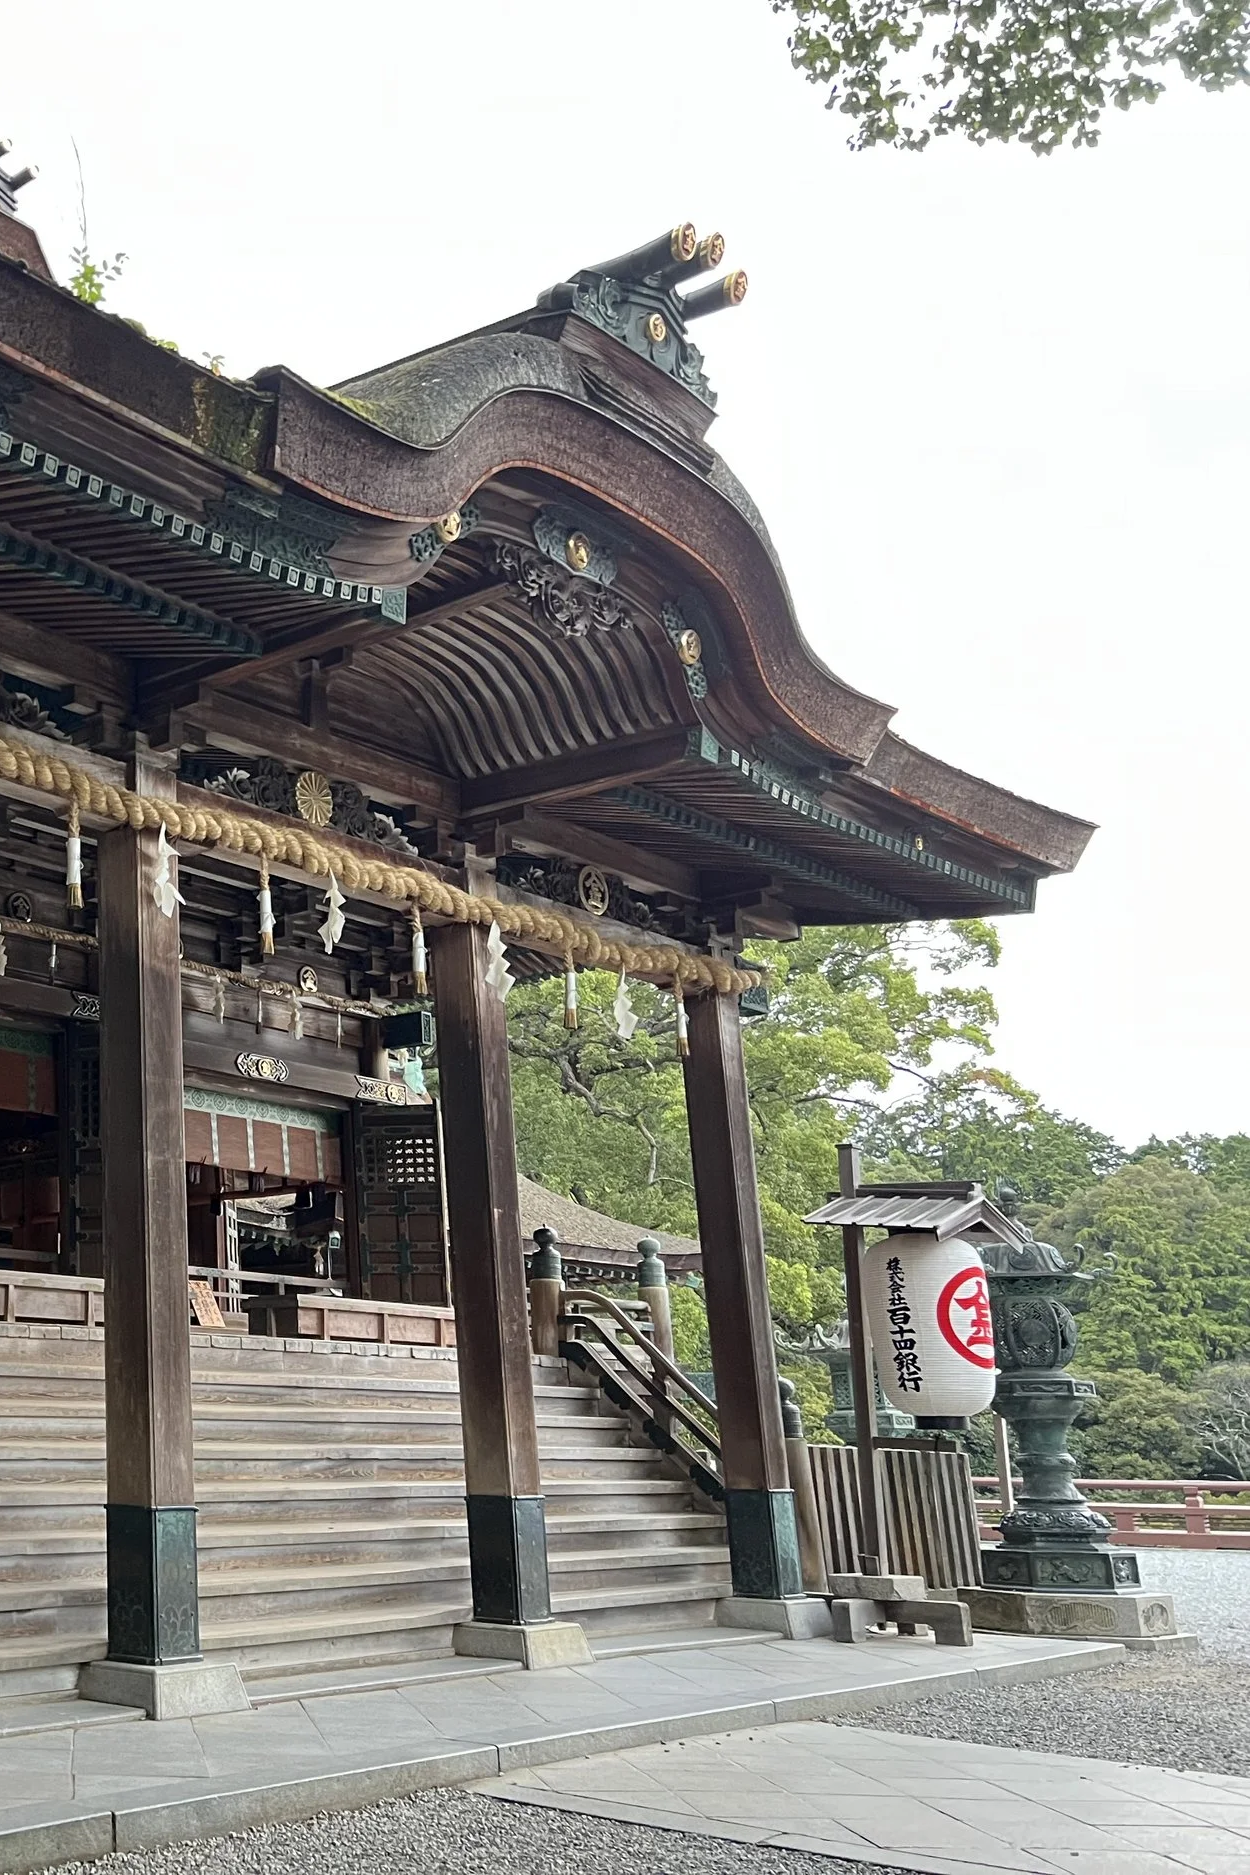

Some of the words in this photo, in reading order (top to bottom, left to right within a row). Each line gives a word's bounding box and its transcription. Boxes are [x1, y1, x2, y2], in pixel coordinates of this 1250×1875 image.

[886, 1256, 923, 1393] 株式会社百十四銀行
[953, 1280, 994, 1348] 金
